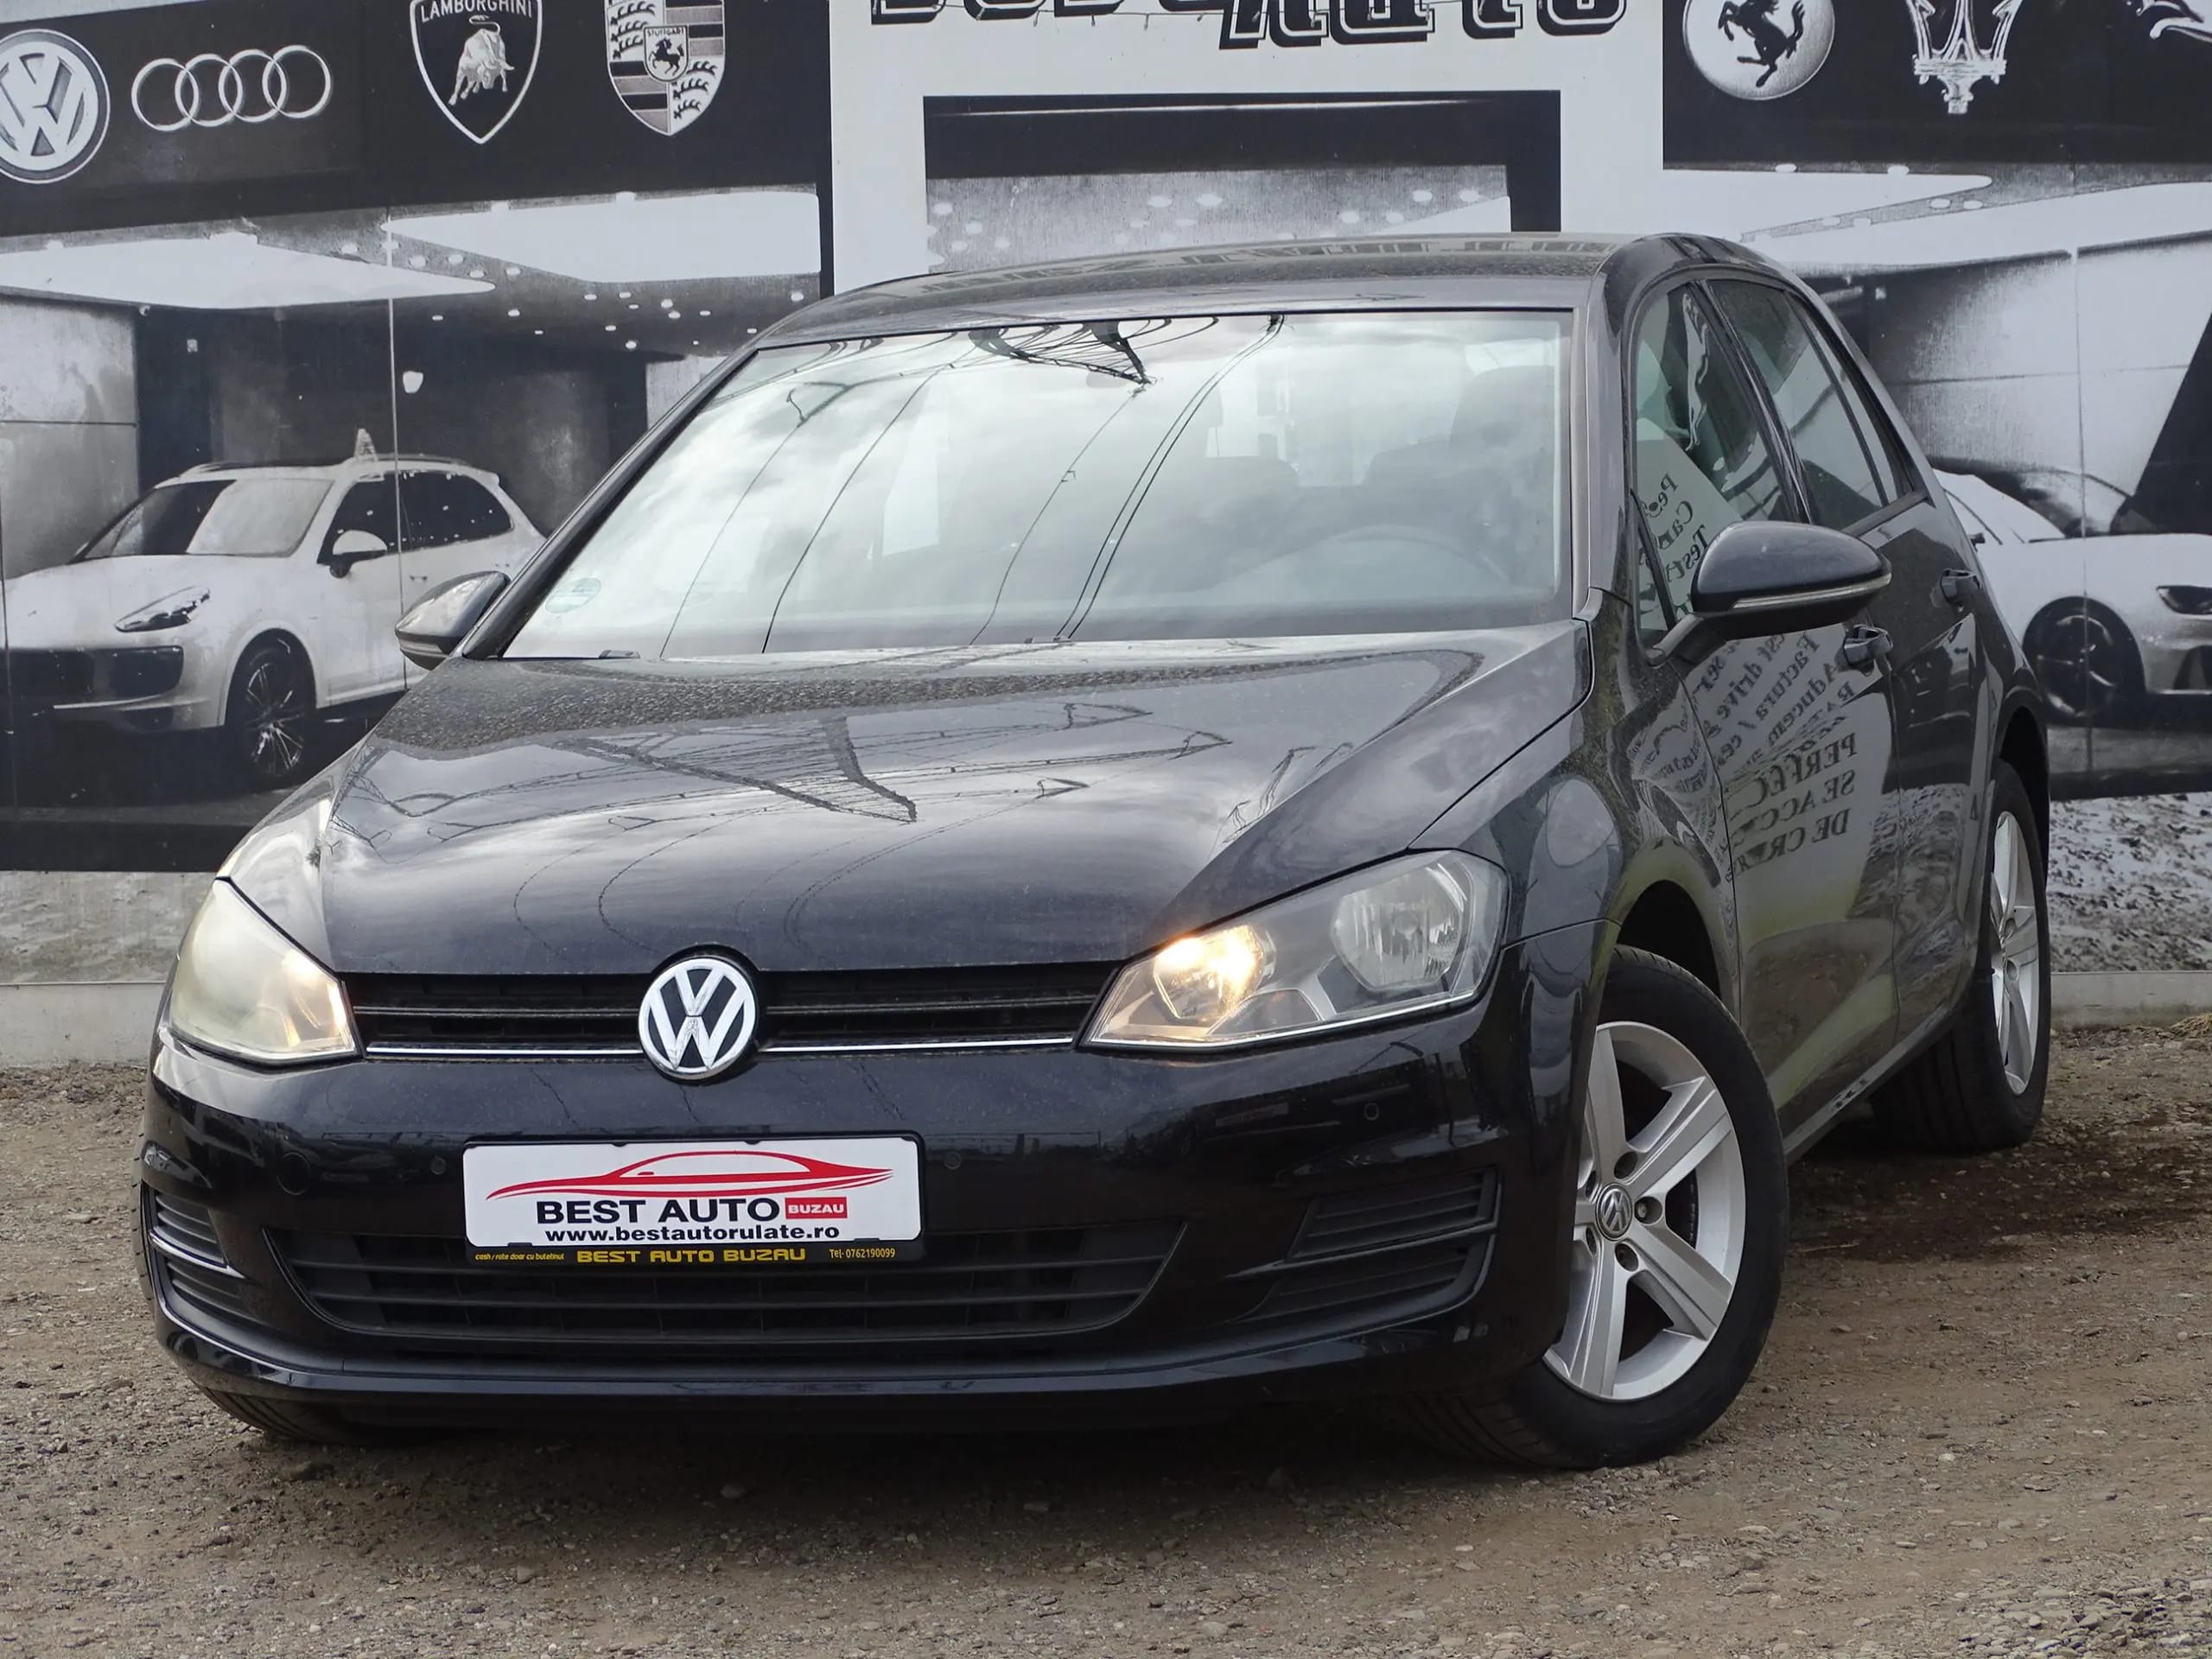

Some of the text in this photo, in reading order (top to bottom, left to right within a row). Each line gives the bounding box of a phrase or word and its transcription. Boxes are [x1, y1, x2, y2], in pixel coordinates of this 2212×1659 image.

[420, 0, 533, 23] LAMBORGHINI
[646, 27, 685, 37] STUTTGART
[536, 1198, 780, 1224] BEST AUTO
[787, 1204, 845, 1215] BUZAU
[544, 1224, 840, 1242] www.bestautorulate.ro
[576, 1247, 806, 1263] BEST AUTO BUZAU
[845, 1247, 896, 1259] 0762190099
